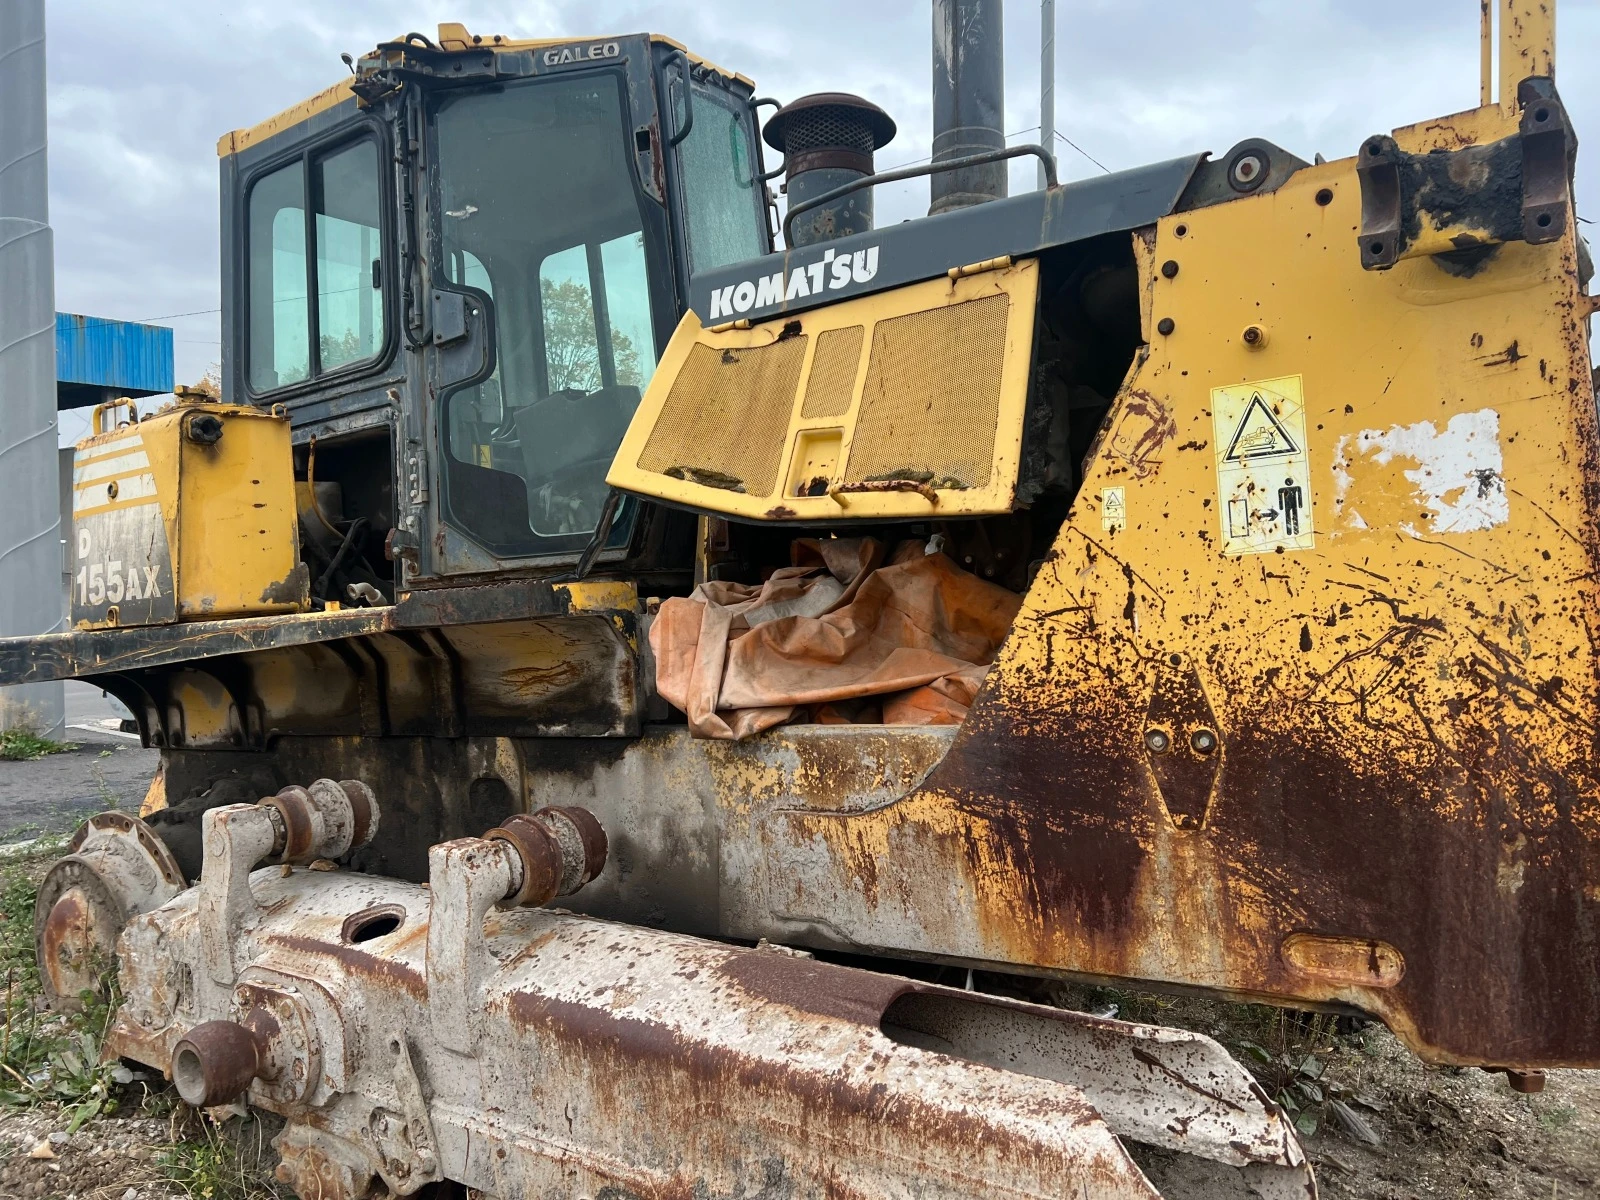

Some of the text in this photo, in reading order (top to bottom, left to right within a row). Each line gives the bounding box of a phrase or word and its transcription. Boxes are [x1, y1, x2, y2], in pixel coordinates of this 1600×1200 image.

[543, 42, 620, 66] GALEO
[709, 246, 880, 320] KOMATSU
[78, 528, 92, 559] D
[76, 560, 162, 606] 155AX
